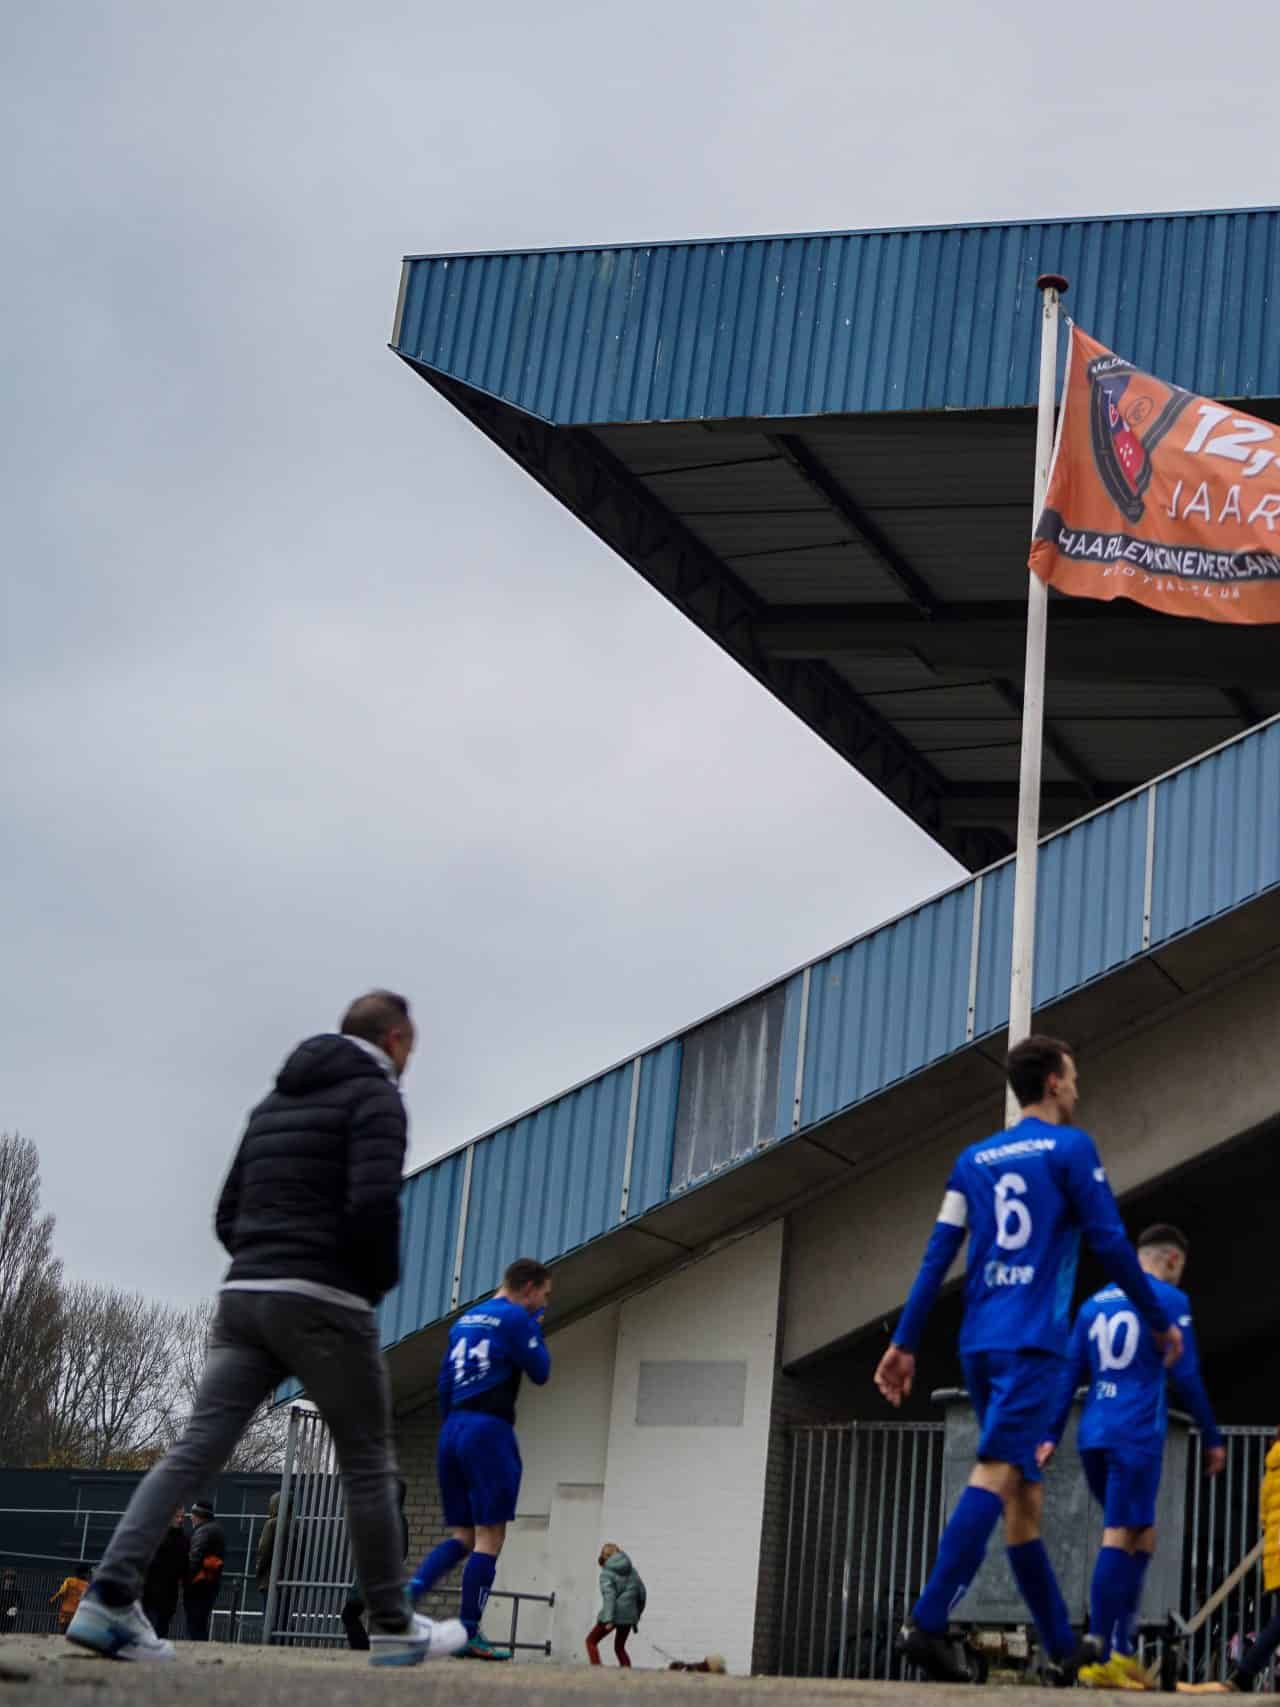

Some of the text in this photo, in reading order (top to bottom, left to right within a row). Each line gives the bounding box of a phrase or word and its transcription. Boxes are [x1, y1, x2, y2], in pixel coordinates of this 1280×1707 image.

[994, 1172, 1032, 1250] 6
[449, 1337, 492, 1386] 11
[1088, 1310, 1140, 1372] 10
